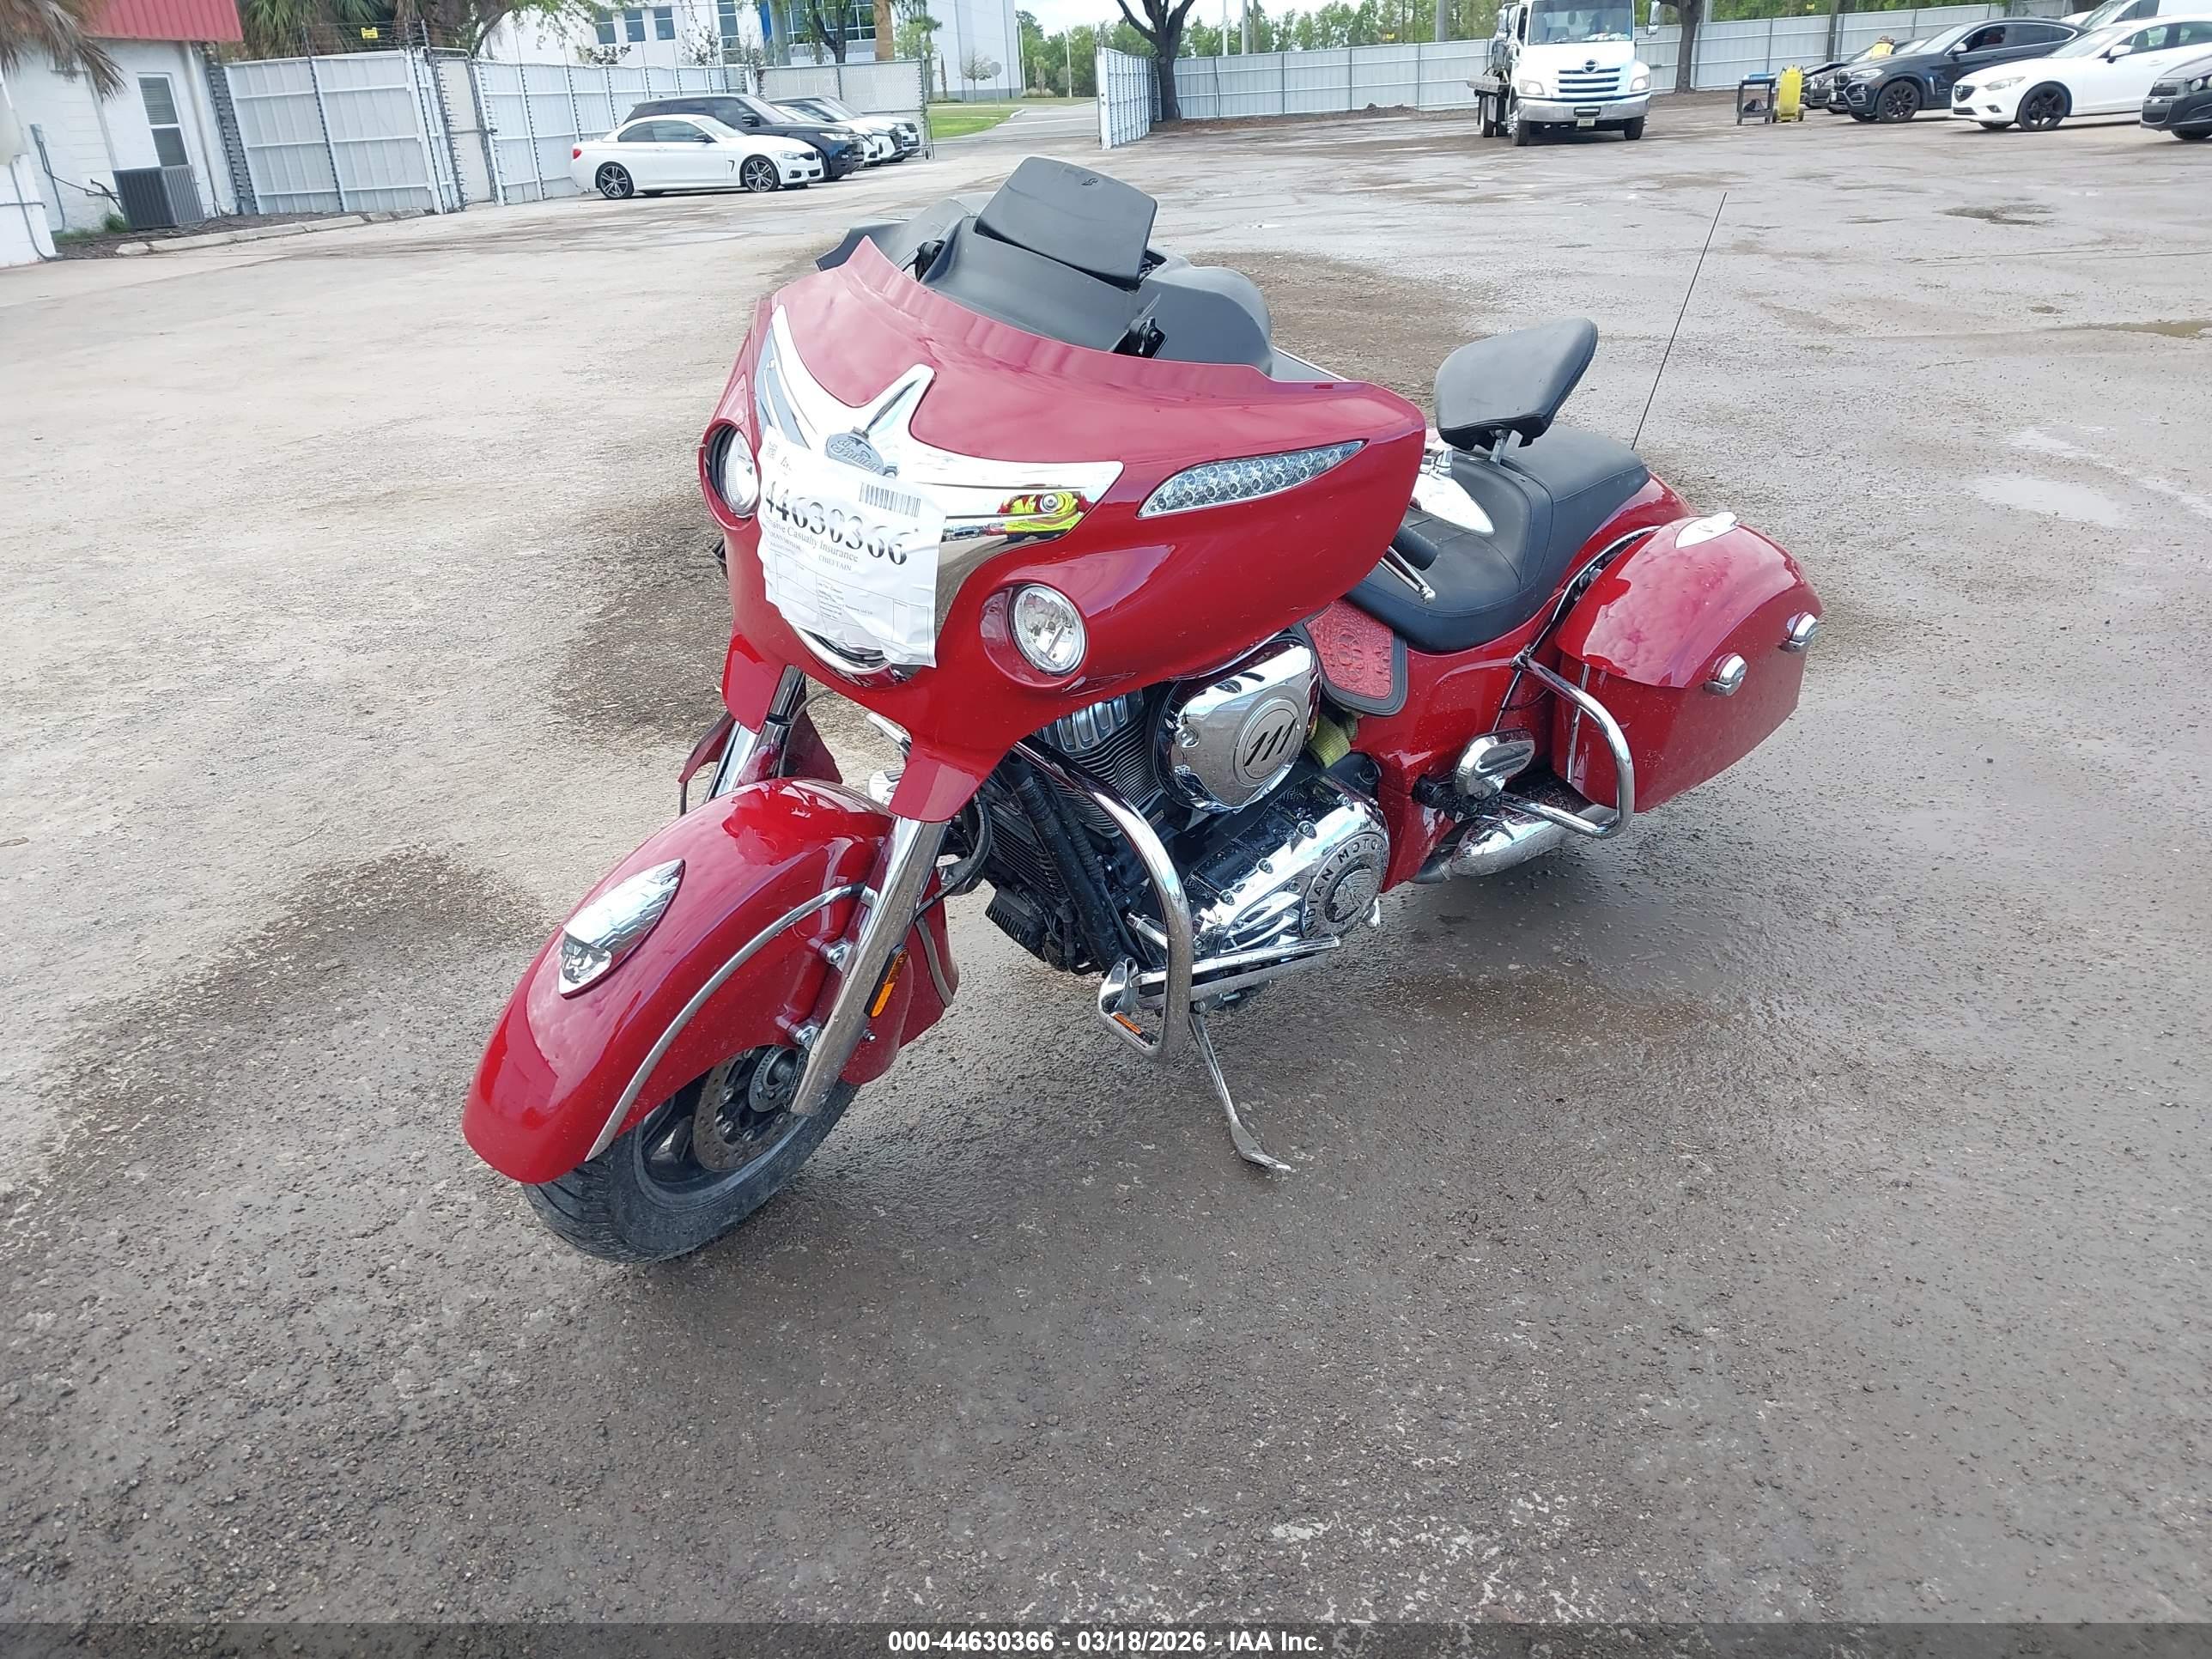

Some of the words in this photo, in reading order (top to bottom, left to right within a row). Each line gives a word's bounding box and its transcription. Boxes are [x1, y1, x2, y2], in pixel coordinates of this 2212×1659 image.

[830, 440, 879, 472] Indian
[765, 481, 910, 565] 44630366
[787, 526, 817, 550] Casualty
[820, 539, 859, 562] Insurance
[818, 555, 852, 571] CHIEFTAIN
